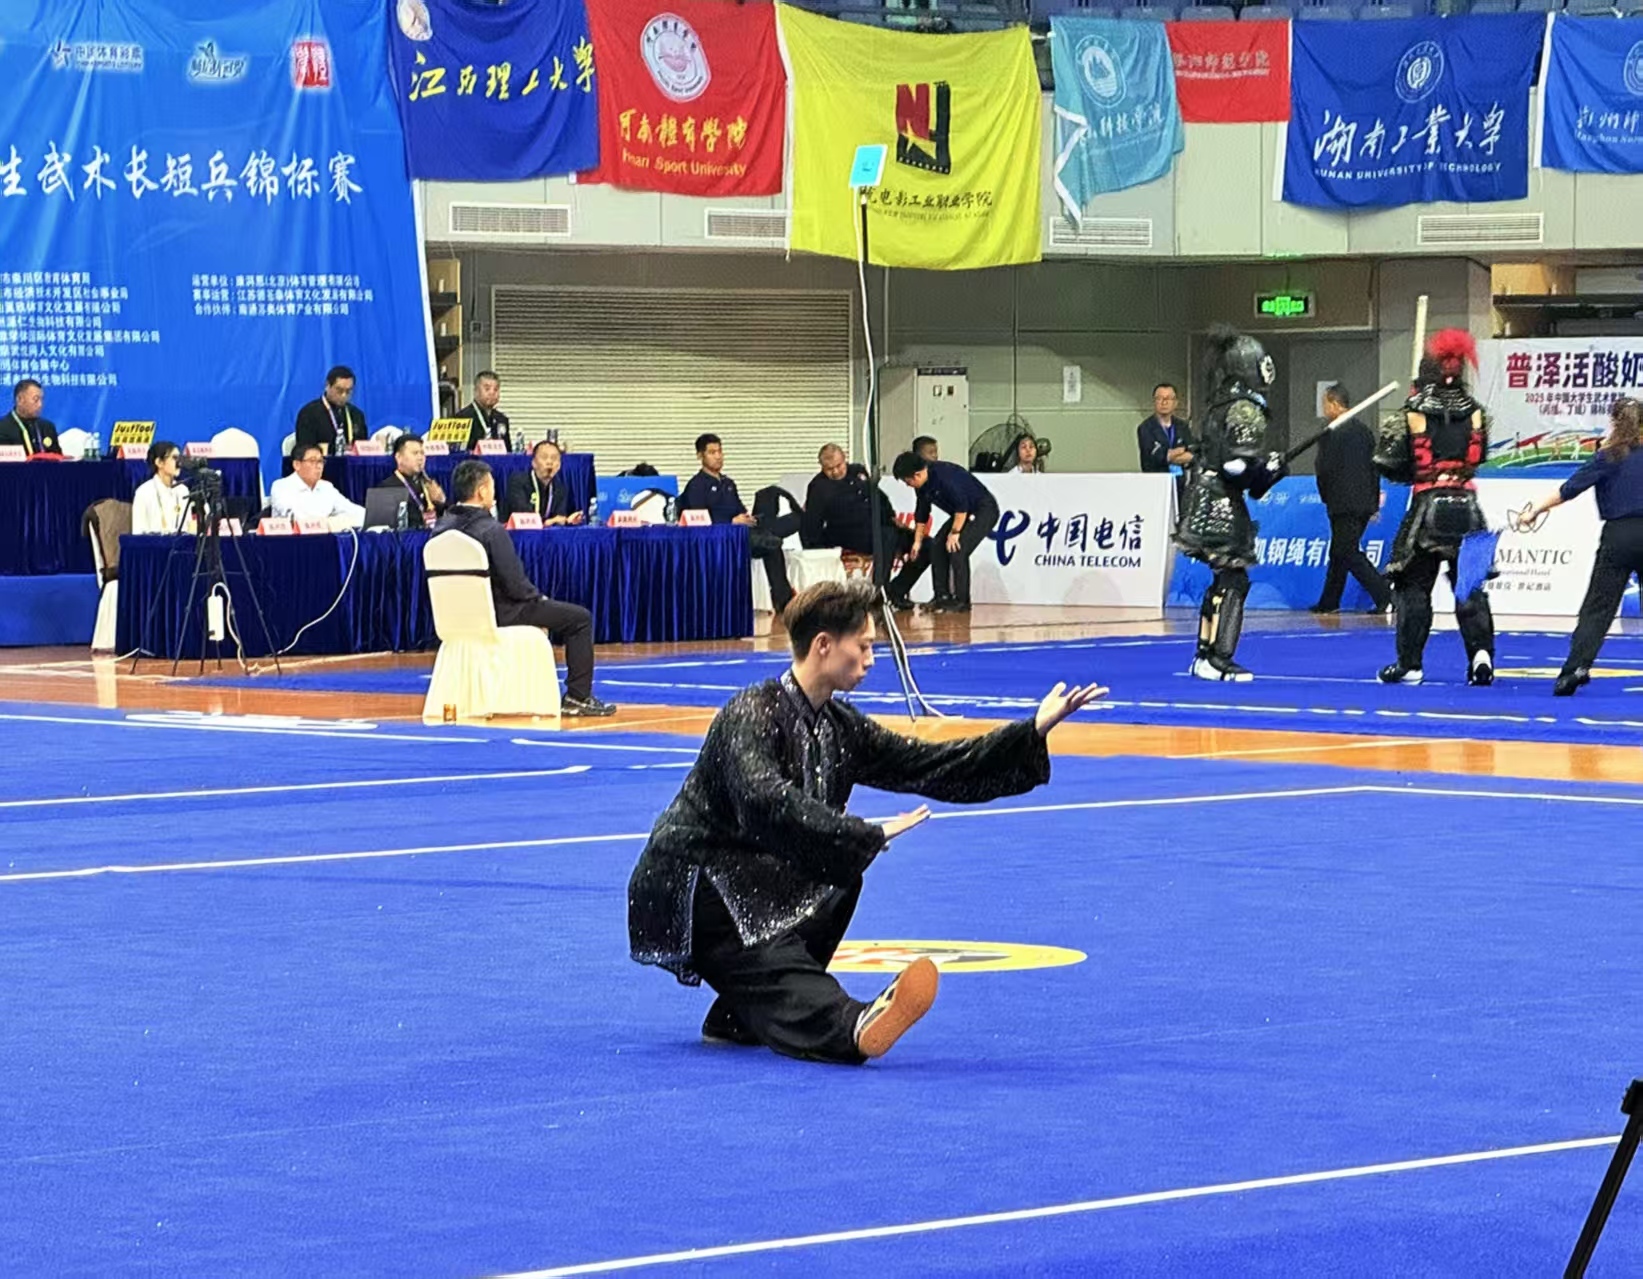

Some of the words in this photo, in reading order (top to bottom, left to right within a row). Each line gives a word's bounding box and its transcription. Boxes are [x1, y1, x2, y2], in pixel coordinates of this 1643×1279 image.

[1506, 350, 1643, 388] 普泽活酸奶
[1037, 511, 1145, 553] 中国电信
[1034, 554, 1076, 568] CHINA
[1080, 555, 1141, 569] TELECOM
[1494, 548, 1573, 565] MANTIC
